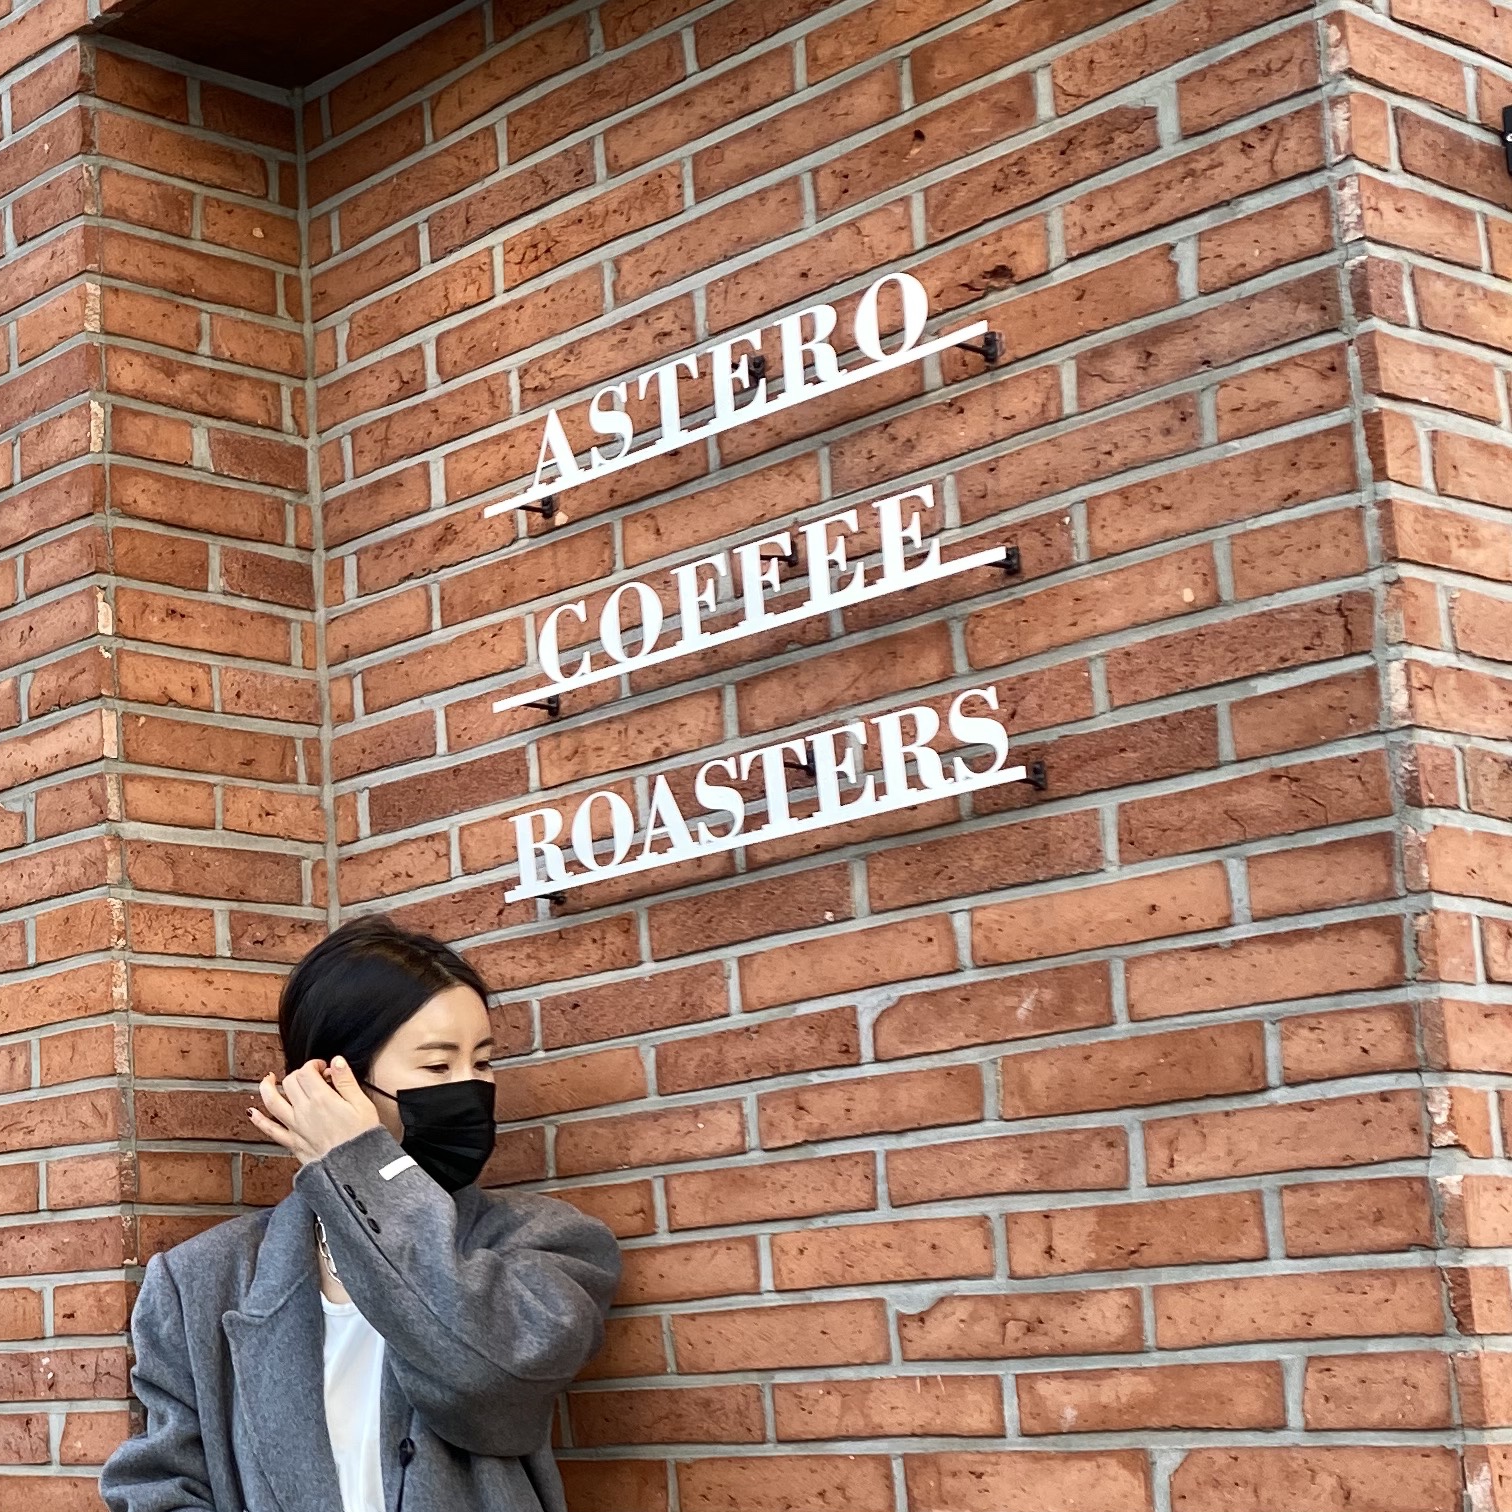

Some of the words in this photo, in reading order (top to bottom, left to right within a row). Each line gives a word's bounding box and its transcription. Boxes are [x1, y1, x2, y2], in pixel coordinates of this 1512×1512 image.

[524, 272, 929, 498] ASTERO
[537, 483, 943, 688] COFFEE
[506, 685, 1011, 895] ROASTERS
